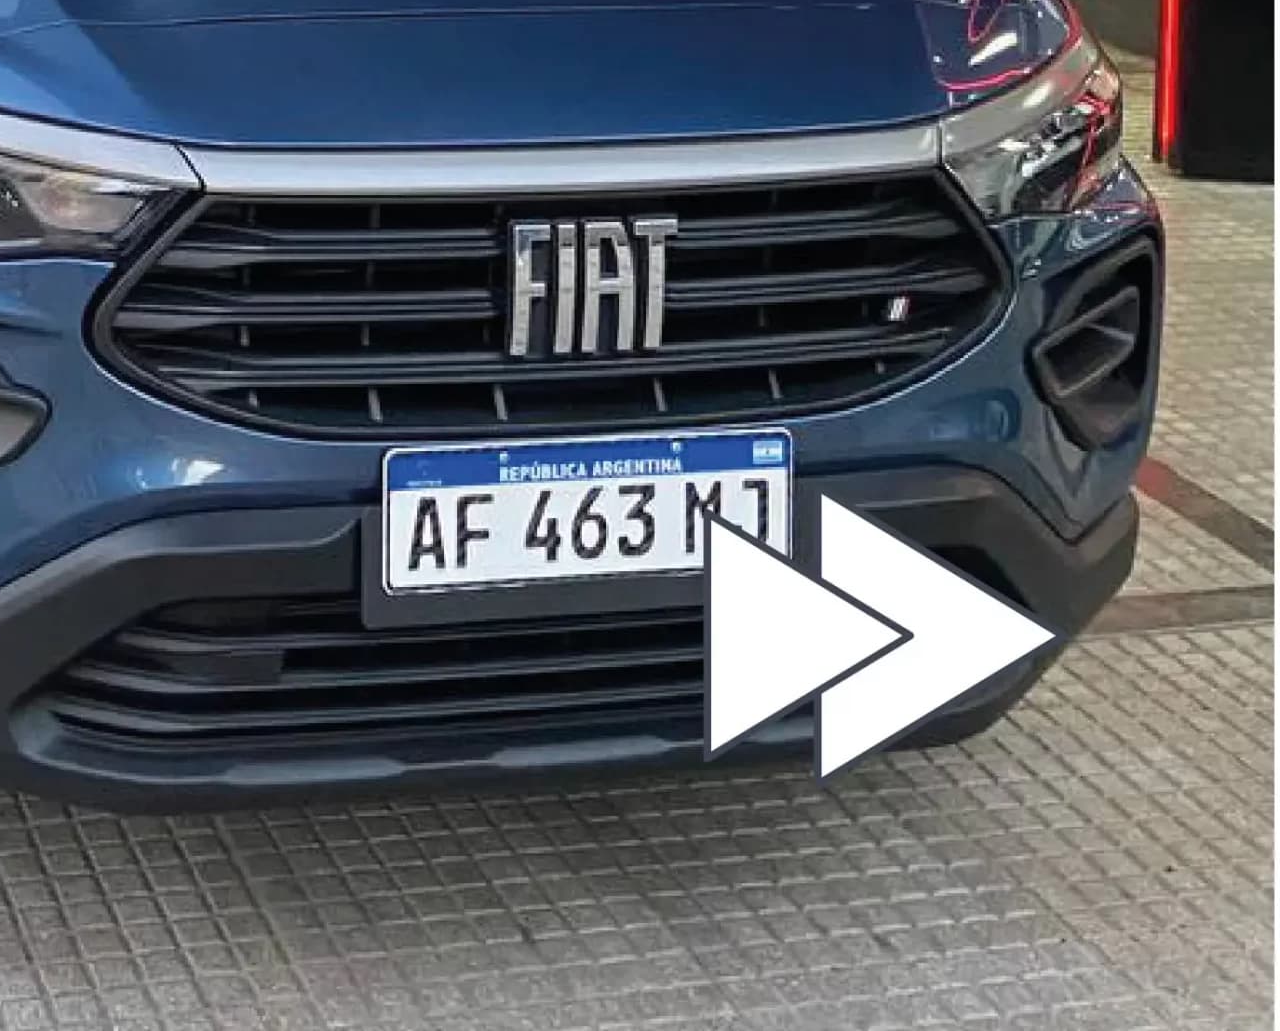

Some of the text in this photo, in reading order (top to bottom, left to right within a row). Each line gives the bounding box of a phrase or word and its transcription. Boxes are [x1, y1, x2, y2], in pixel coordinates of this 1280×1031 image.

[509, 217, 679, 357] FIAT
[499, 457, 682, 484] REPÚBLICA ARGENTINA
[407, 492, 494, 572] AF
[524, 483, 657, 563] 463
